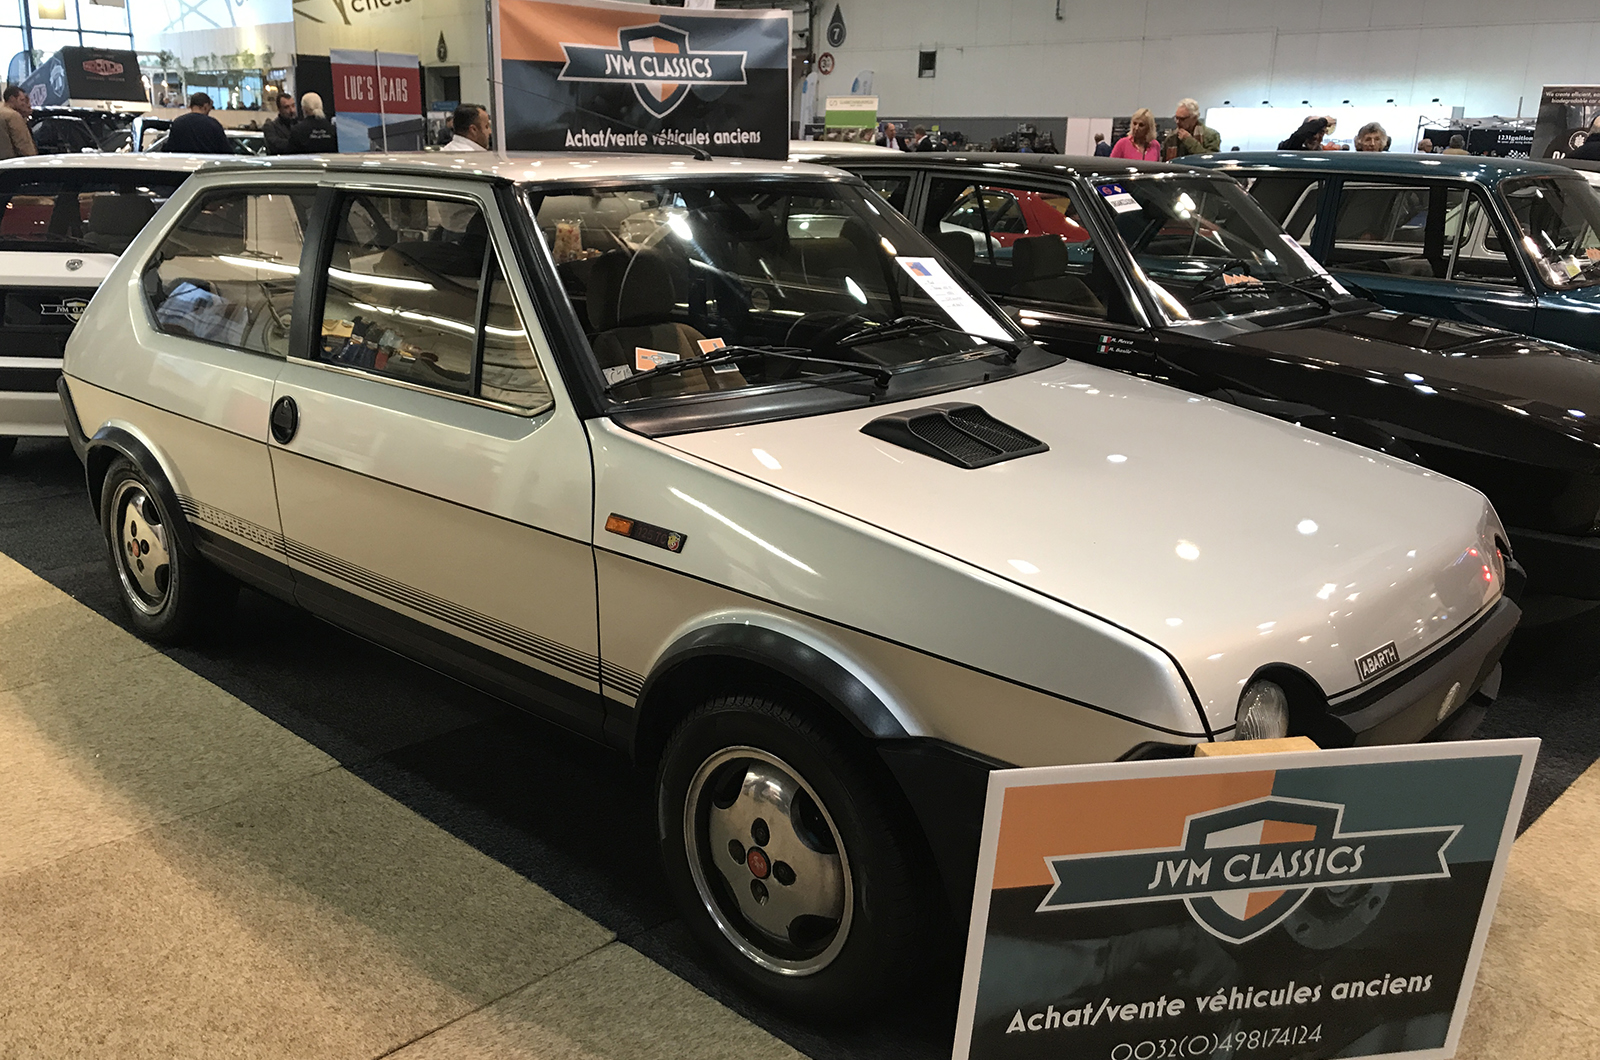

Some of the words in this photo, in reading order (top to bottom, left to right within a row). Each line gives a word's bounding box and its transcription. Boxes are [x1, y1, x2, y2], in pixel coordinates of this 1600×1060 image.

[833, 28, 840, 40] 7
[605, 53, 636, 76] JVM
[640, 56, 713, 78] CLASSICS
[344, 75, 373, 101] LUC'S
[381, 77, 408, 103] CARS
[565, 127, 648, 148] Achat/vente
[652, 128, 710, 146] véhicules
[713, 128, 761, 144] anciens
[636, 525, 654, 541] 125
[655, 531, 667, 545] TC
[1362, 646, 1397, 677] ABARTH
[1148, 857, 1213, 890] JVM
[1223, 845, 1366, 883] CLASSICS
[1006, 997, 1185, 1034] Achat/vente
[1196, 980, 1322, 1014] véhicules
[1331, 971, 1433, 1001] anciens
[1110, 1023, 1323, 1060] 0032(0)498174124
